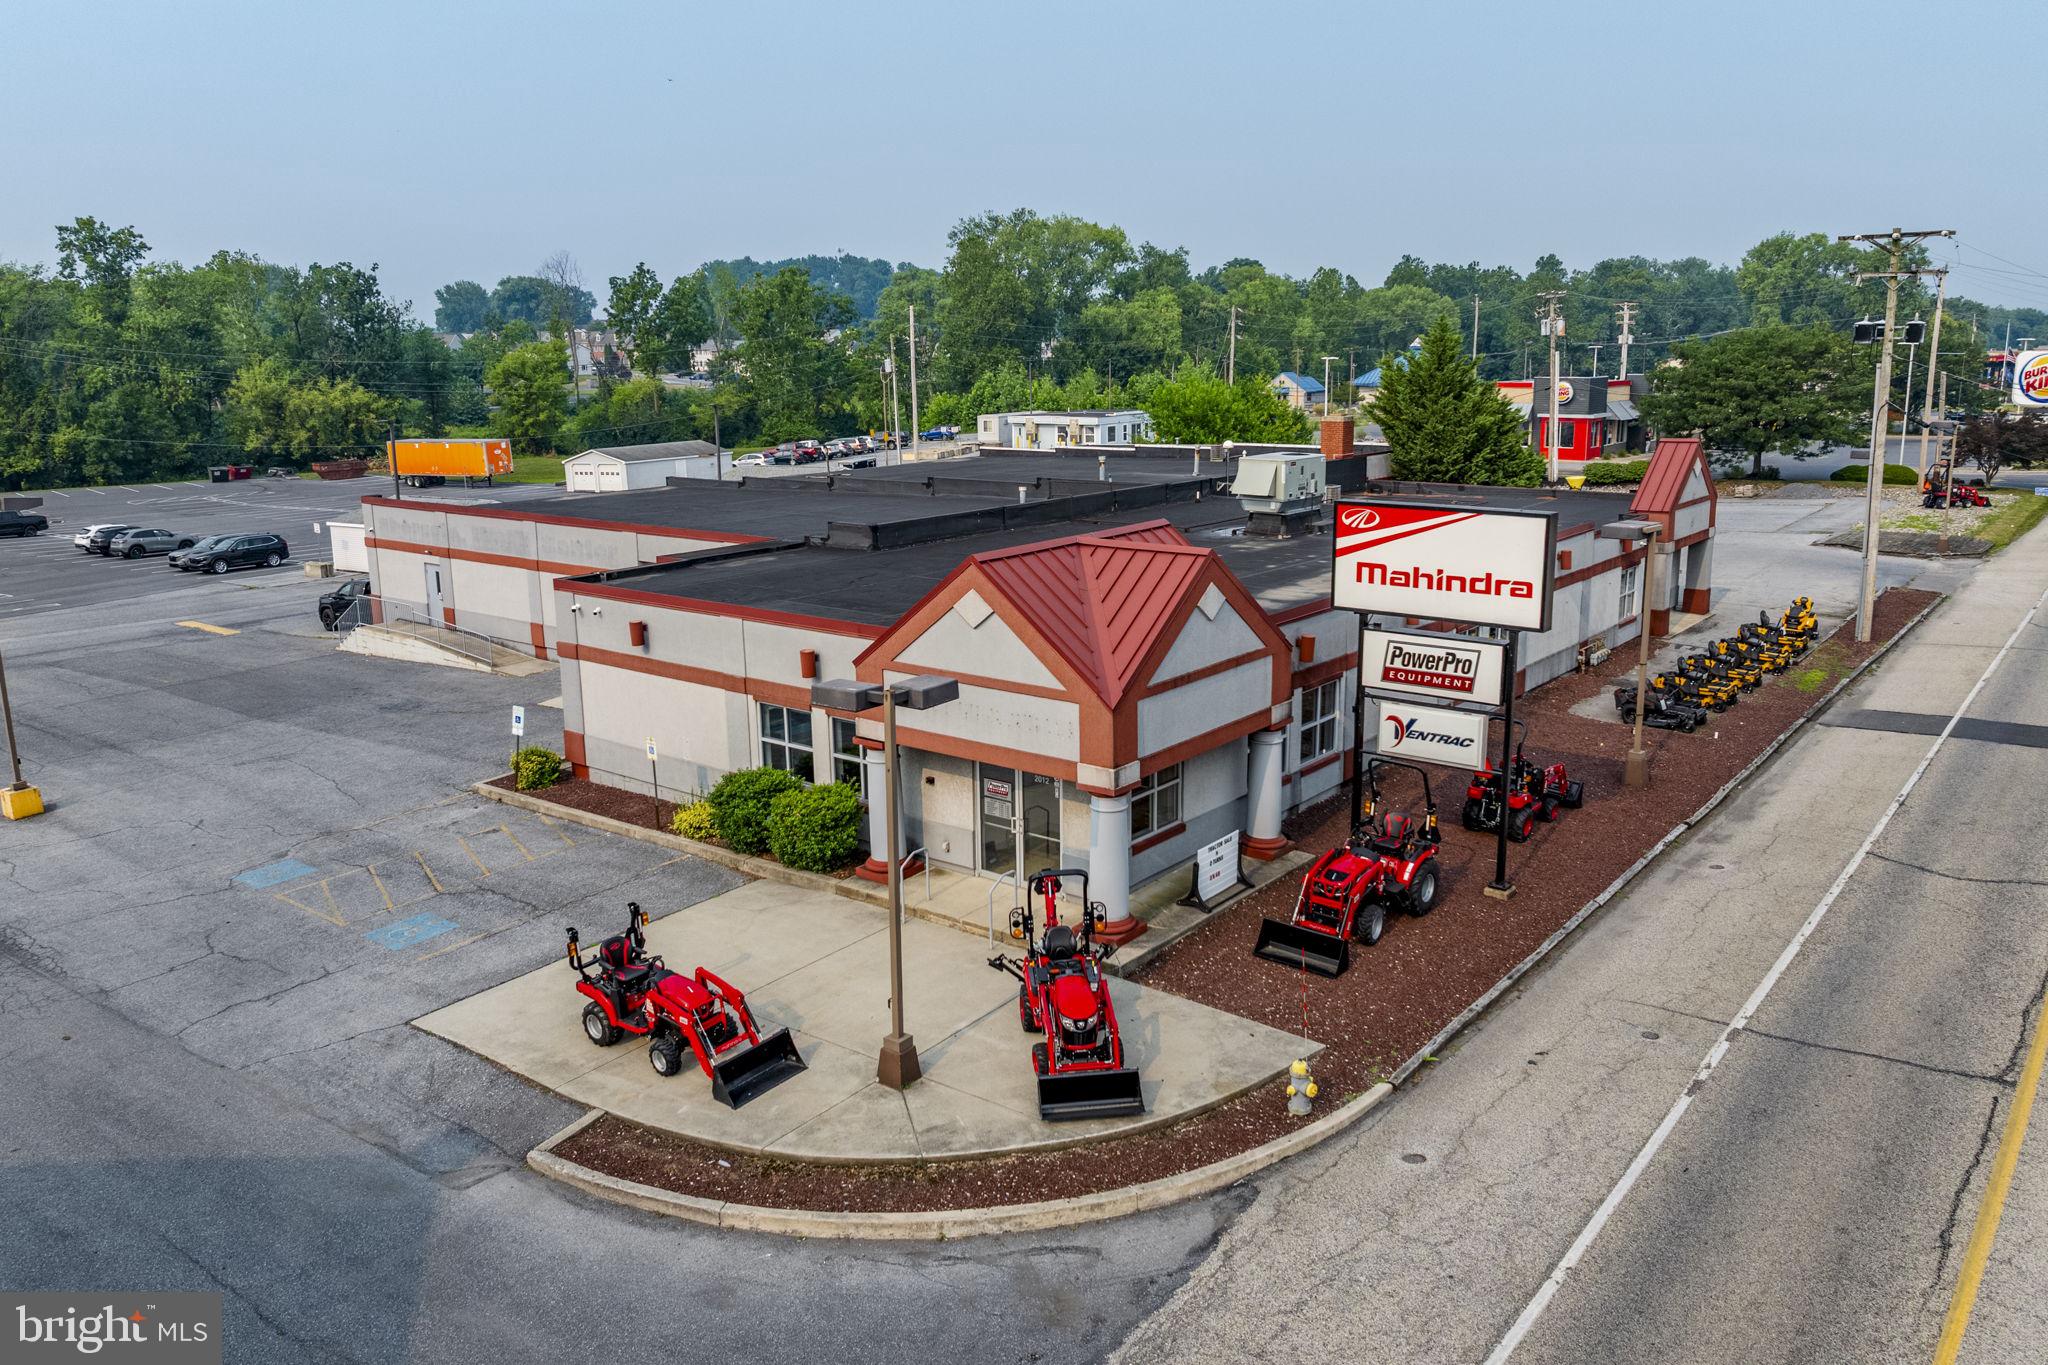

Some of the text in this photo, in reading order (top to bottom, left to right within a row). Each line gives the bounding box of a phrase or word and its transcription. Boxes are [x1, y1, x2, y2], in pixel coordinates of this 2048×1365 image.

[1356, 562, 1533, 599] Mahindra
[1389, 646, 1473, 675] PowerPro
[1389, 670, 1471, 688] EQUIPMENT
[1385, 715, 1475, 748] VENTRAC
[1034, 775, 1050, 785] 2012
